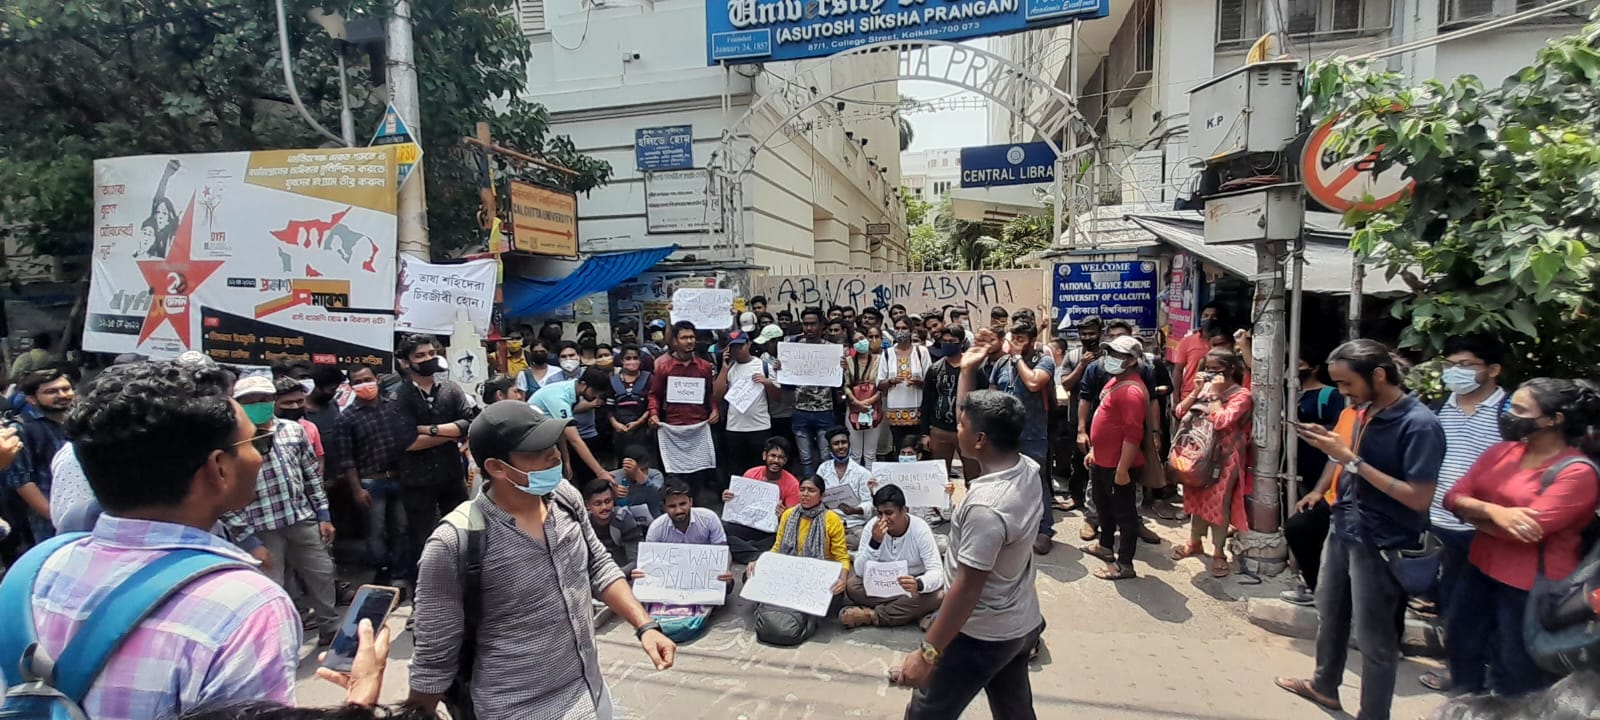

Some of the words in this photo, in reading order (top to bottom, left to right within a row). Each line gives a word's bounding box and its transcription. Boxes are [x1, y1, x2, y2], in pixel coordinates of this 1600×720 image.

[776, 18, 855, 45] (ASUTOSH
[859, 10, 920, 32] SIKSHA
[924, 0, 1019, 23] PRANGAN)
[831, 38, 866, 48] College
[868, 33, 899, 43] Street,
[902, 25, 959, 39] Kolkata-700
[961, 22, 980, 31] 073
[1206, 115, 1224, 129] K.P
[638, 134, 665, 147] হলিডে
[669, 134, 690, 145] হোম
[963, 167, 1015, 182] CENTRAL
[513, 202, 542, 219] CALCUTTA
[542, 209, 573, 224] UNIVERSITY
[1080, 262, 1131, 272] WELCOME
[418, 273, 439, 285] ভাষা
[442, 274, 485, 292] শহিদেরা
[1059, 281, 1092, 290] NATIONAL
[1093, 281, 1122, 290] SERVICE
[1123, 280, 1151, 289] SCHEME
[109, 287, 153, 314] dyfi
[413, 287, 452, 304] চিরজীবী
[1059, 293, 1100, 302] UNIVERSITY
[1101, 293, 1111, 301] OF
[1112, 292, 1151, 301] CALCUTTA
[560, 408, 567, 419] 3
[651, 547, 680, 566] WE
[688, 549, 728, 566] WANT
[647, 567, 721, 590] ONLINE
